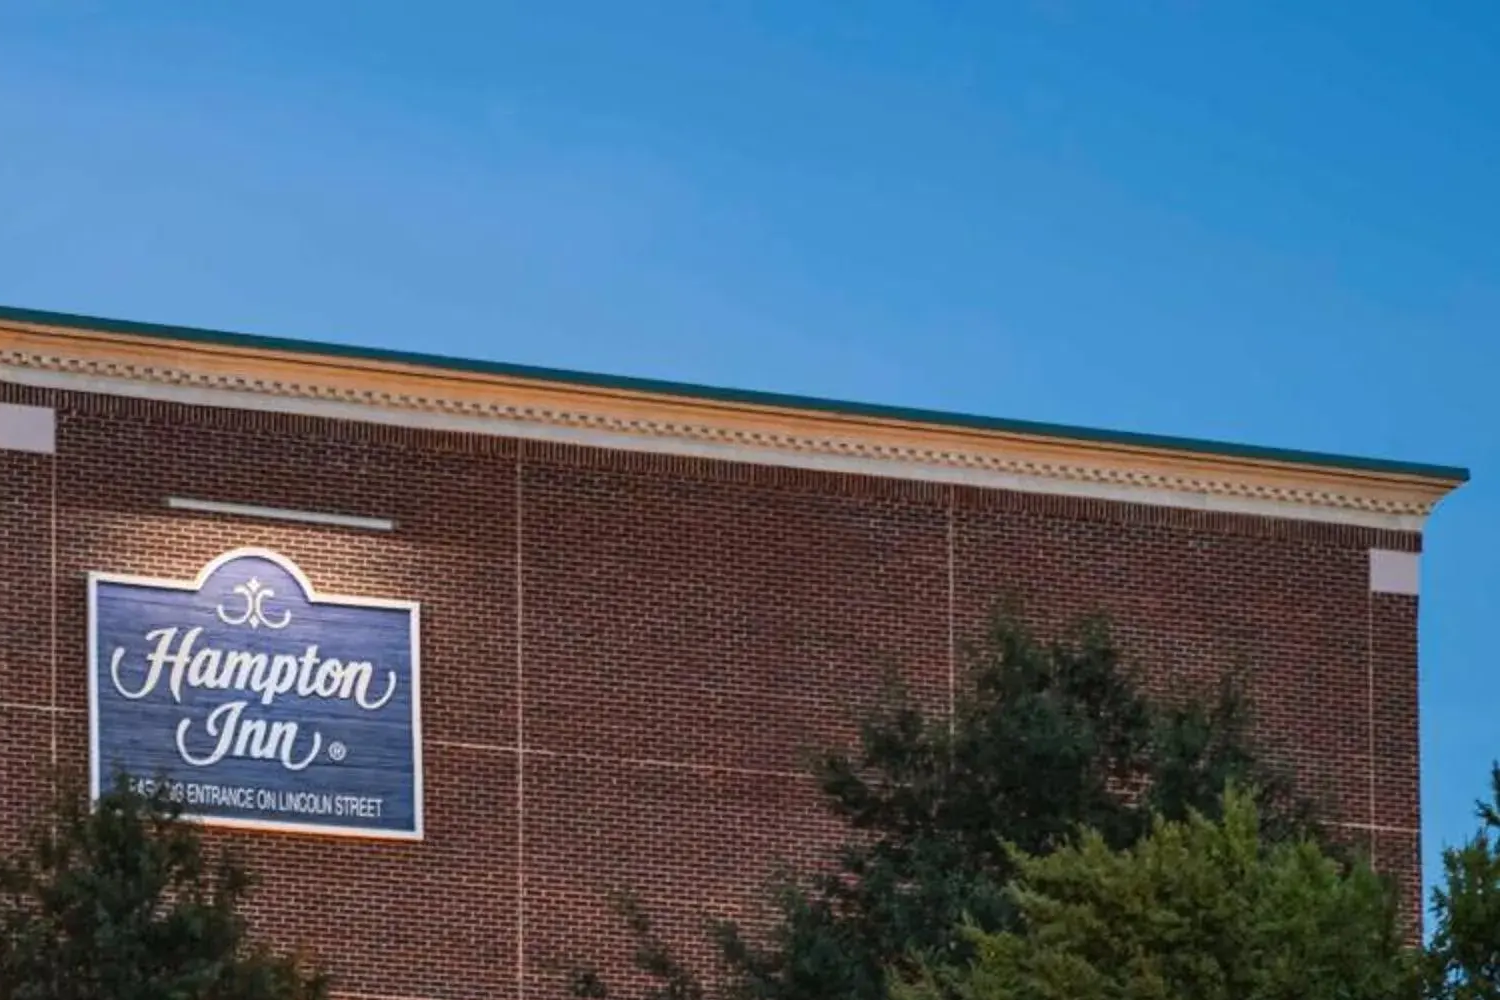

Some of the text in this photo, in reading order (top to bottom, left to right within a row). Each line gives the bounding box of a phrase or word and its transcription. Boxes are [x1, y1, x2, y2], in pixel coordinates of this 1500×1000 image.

[111, 627, 397, 709] Hampton
[176, 701, 322, 770] Inn
[187, 783, 254, 809] ENTRANCE
[257, 789, 276, 811] ON
[278, 791, 332, 814] LINCOLN
[334, 796, 383, 818] STREET
